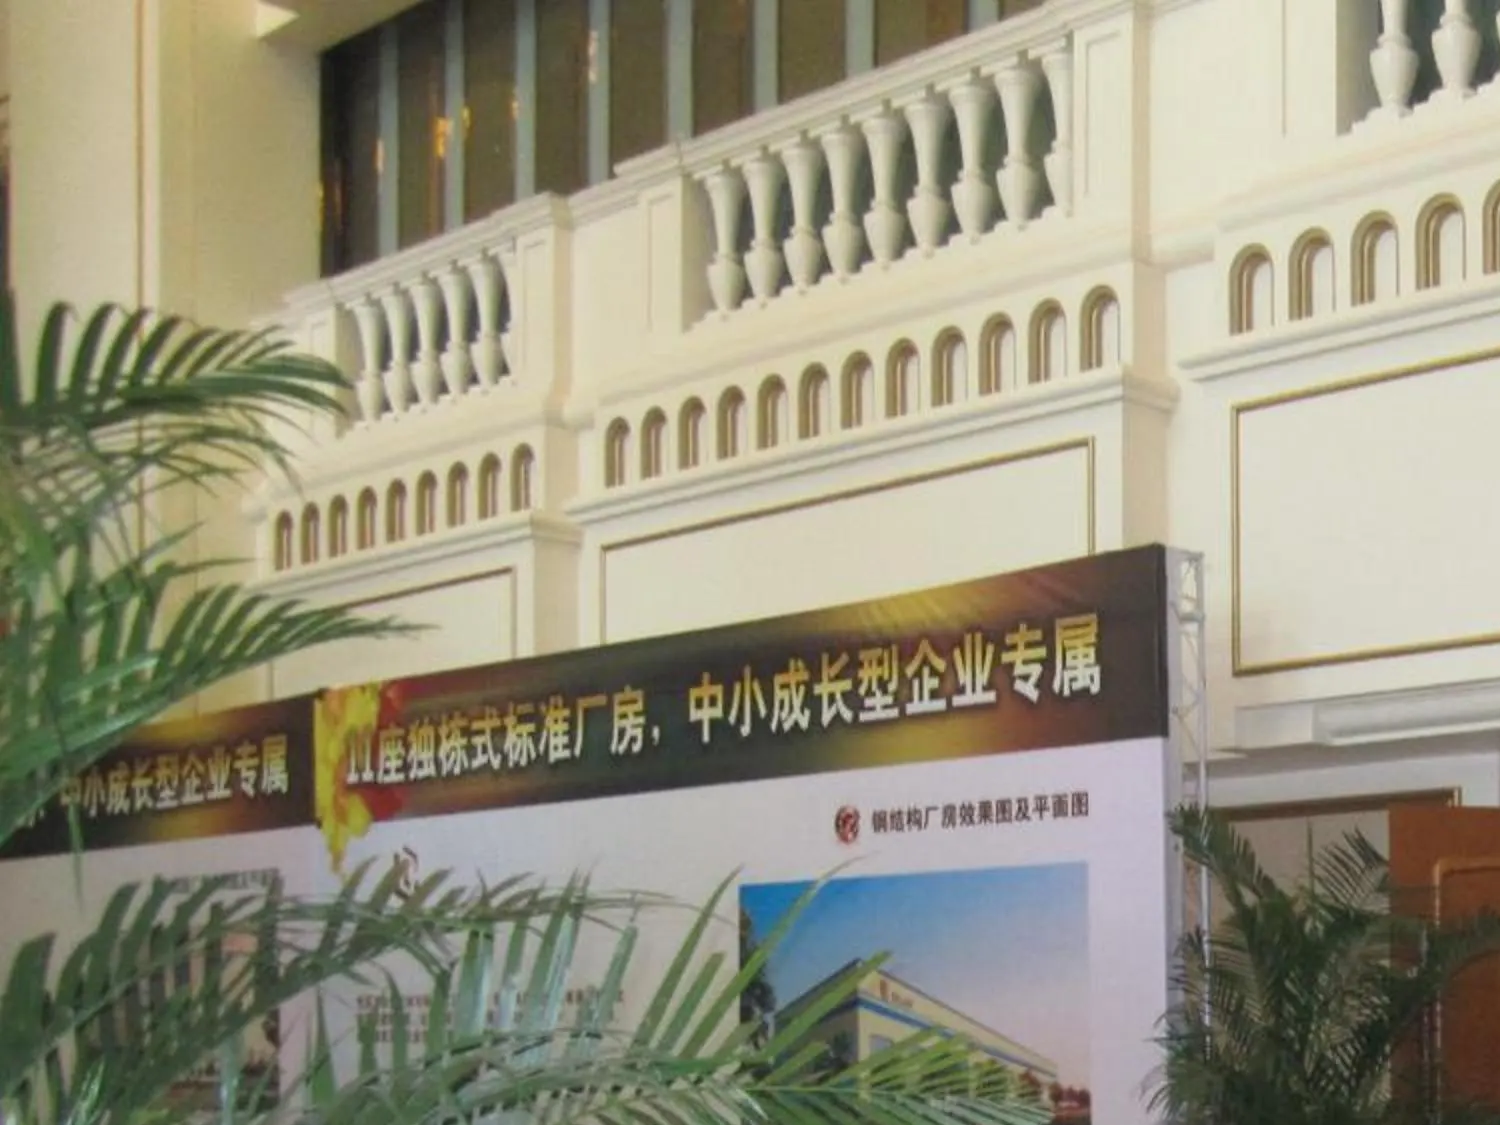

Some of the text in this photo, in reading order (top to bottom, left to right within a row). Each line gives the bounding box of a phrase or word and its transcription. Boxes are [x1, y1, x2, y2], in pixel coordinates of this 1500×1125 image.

[871, 791, 1090, 833] 钢结构厂房效果图及平面图
